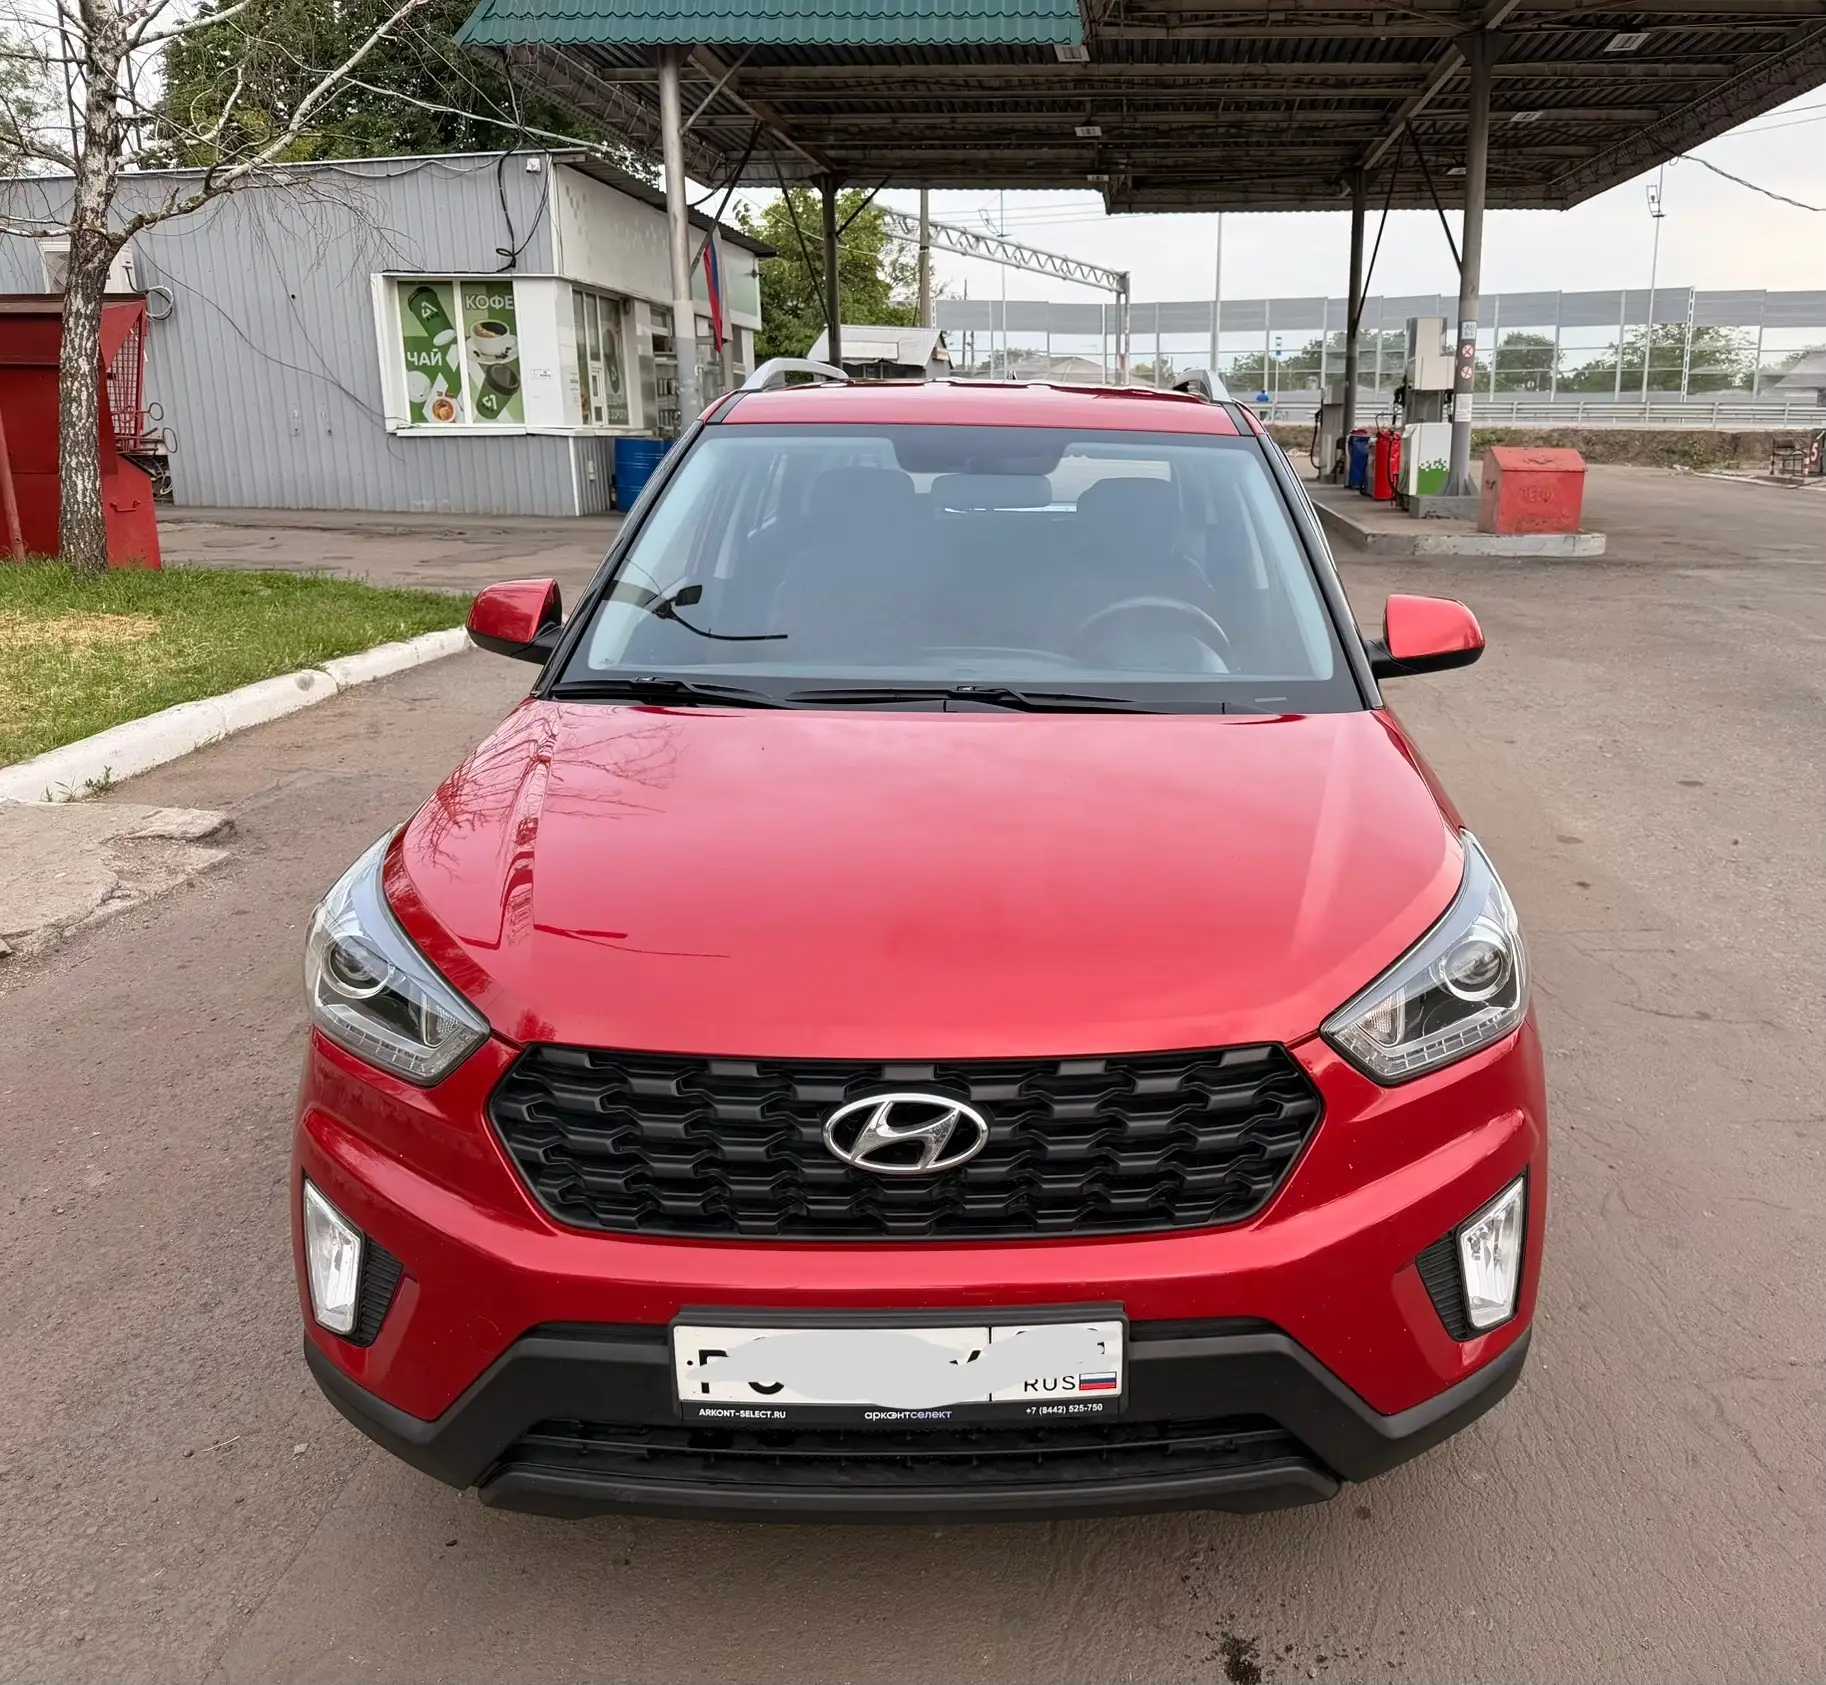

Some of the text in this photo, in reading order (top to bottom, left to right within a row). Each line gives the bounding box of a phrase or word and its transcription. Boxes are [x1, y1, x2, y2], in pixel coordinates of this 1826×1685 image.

[465, 294, 514, 310] КОФЕ
[407, 348, 442, 366] ЧАЙ
[1024, 1375, 1076, 1392] RUS
[698, 1408, 787, 1419] ARKONT-SELECT.RU
[1025, 1403, 1103, 1416] +7 (8442) 525-750
